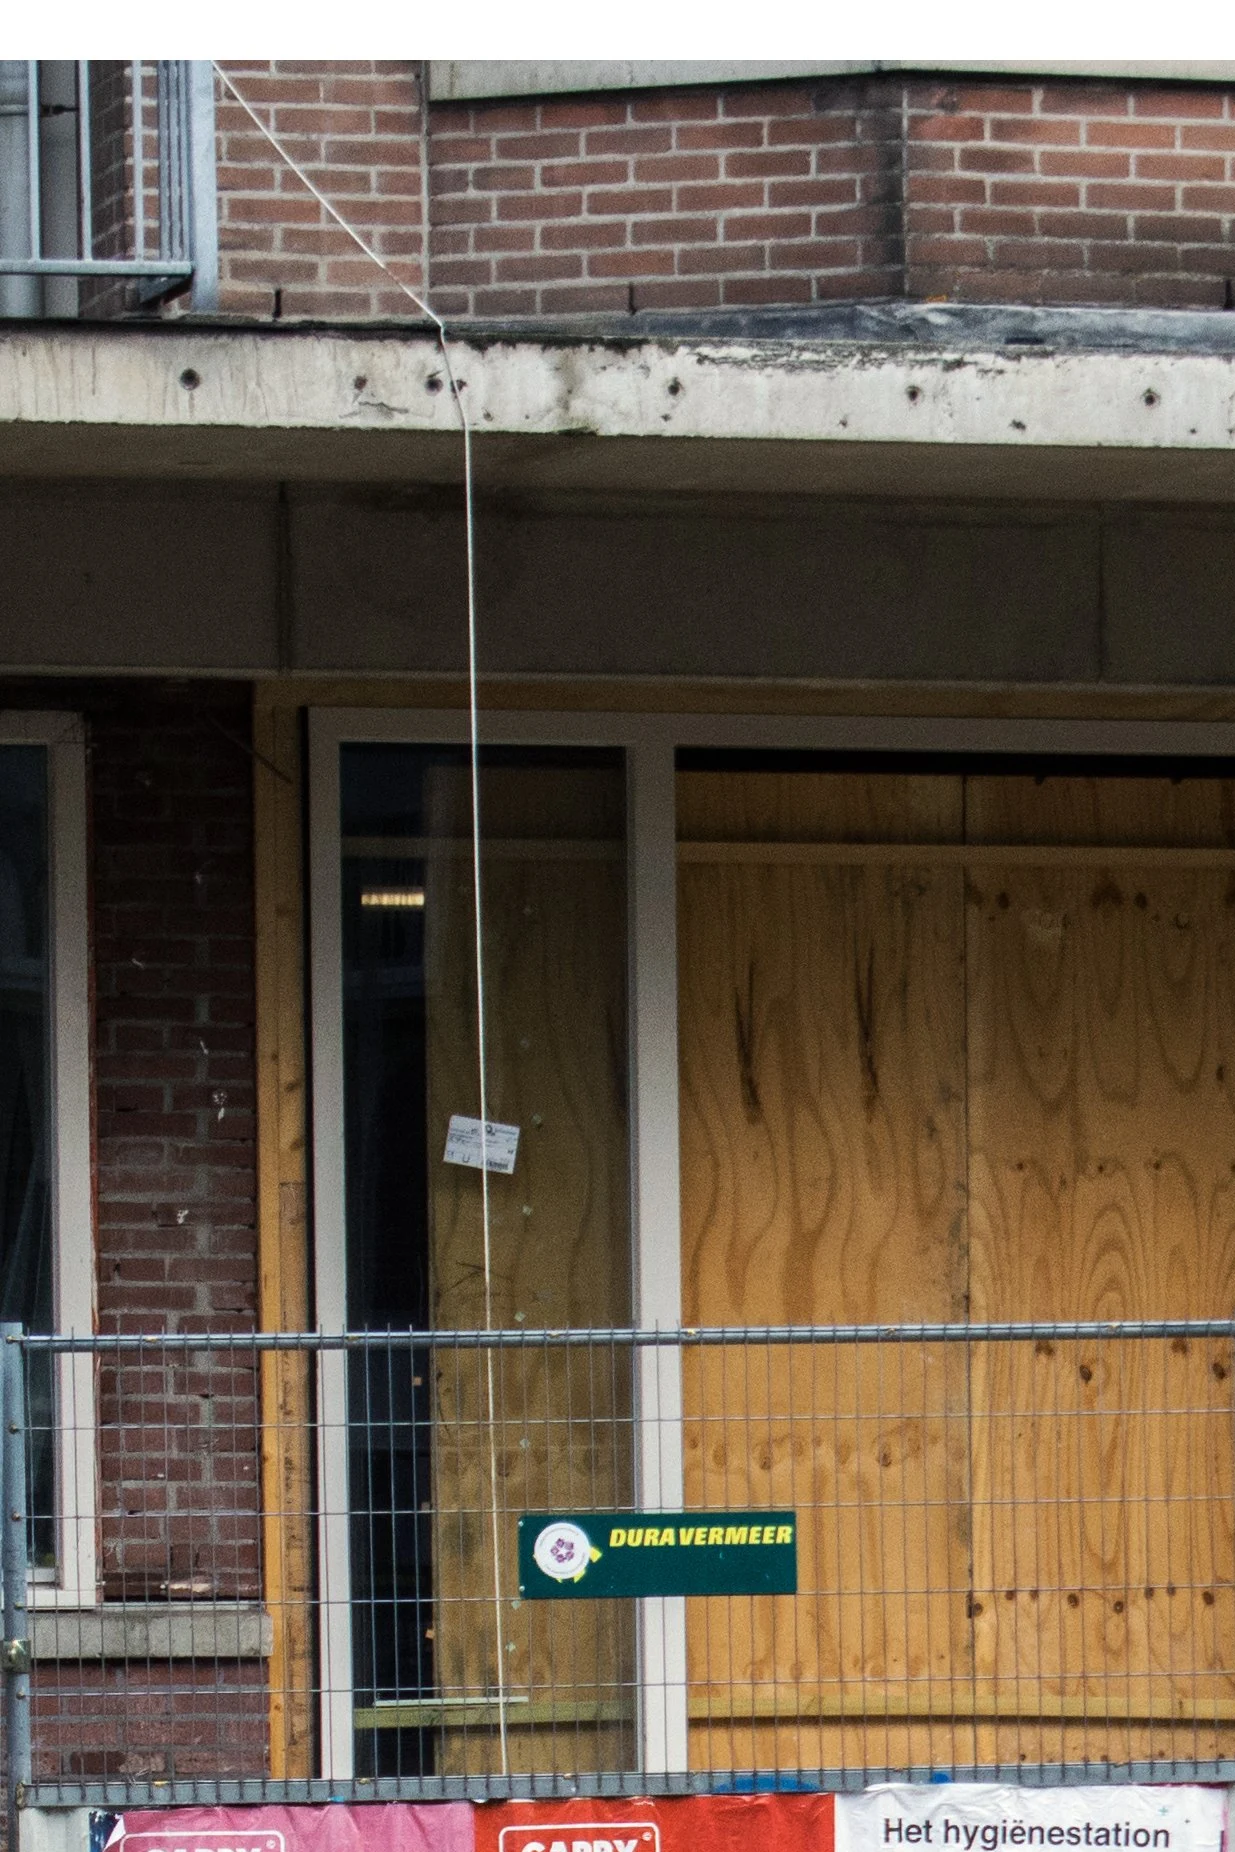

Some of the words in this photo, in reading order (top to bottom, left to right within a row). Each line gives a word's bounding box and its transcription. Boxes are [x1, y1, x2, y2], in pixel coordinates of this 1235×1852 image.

[609, 1528, 675, 1547] DURA
[679, 1526, 792, 1545] VERMEER
[884, 1818, 932, 1843] Het
[944, 1819, 1170, 1850] hygiënestation
